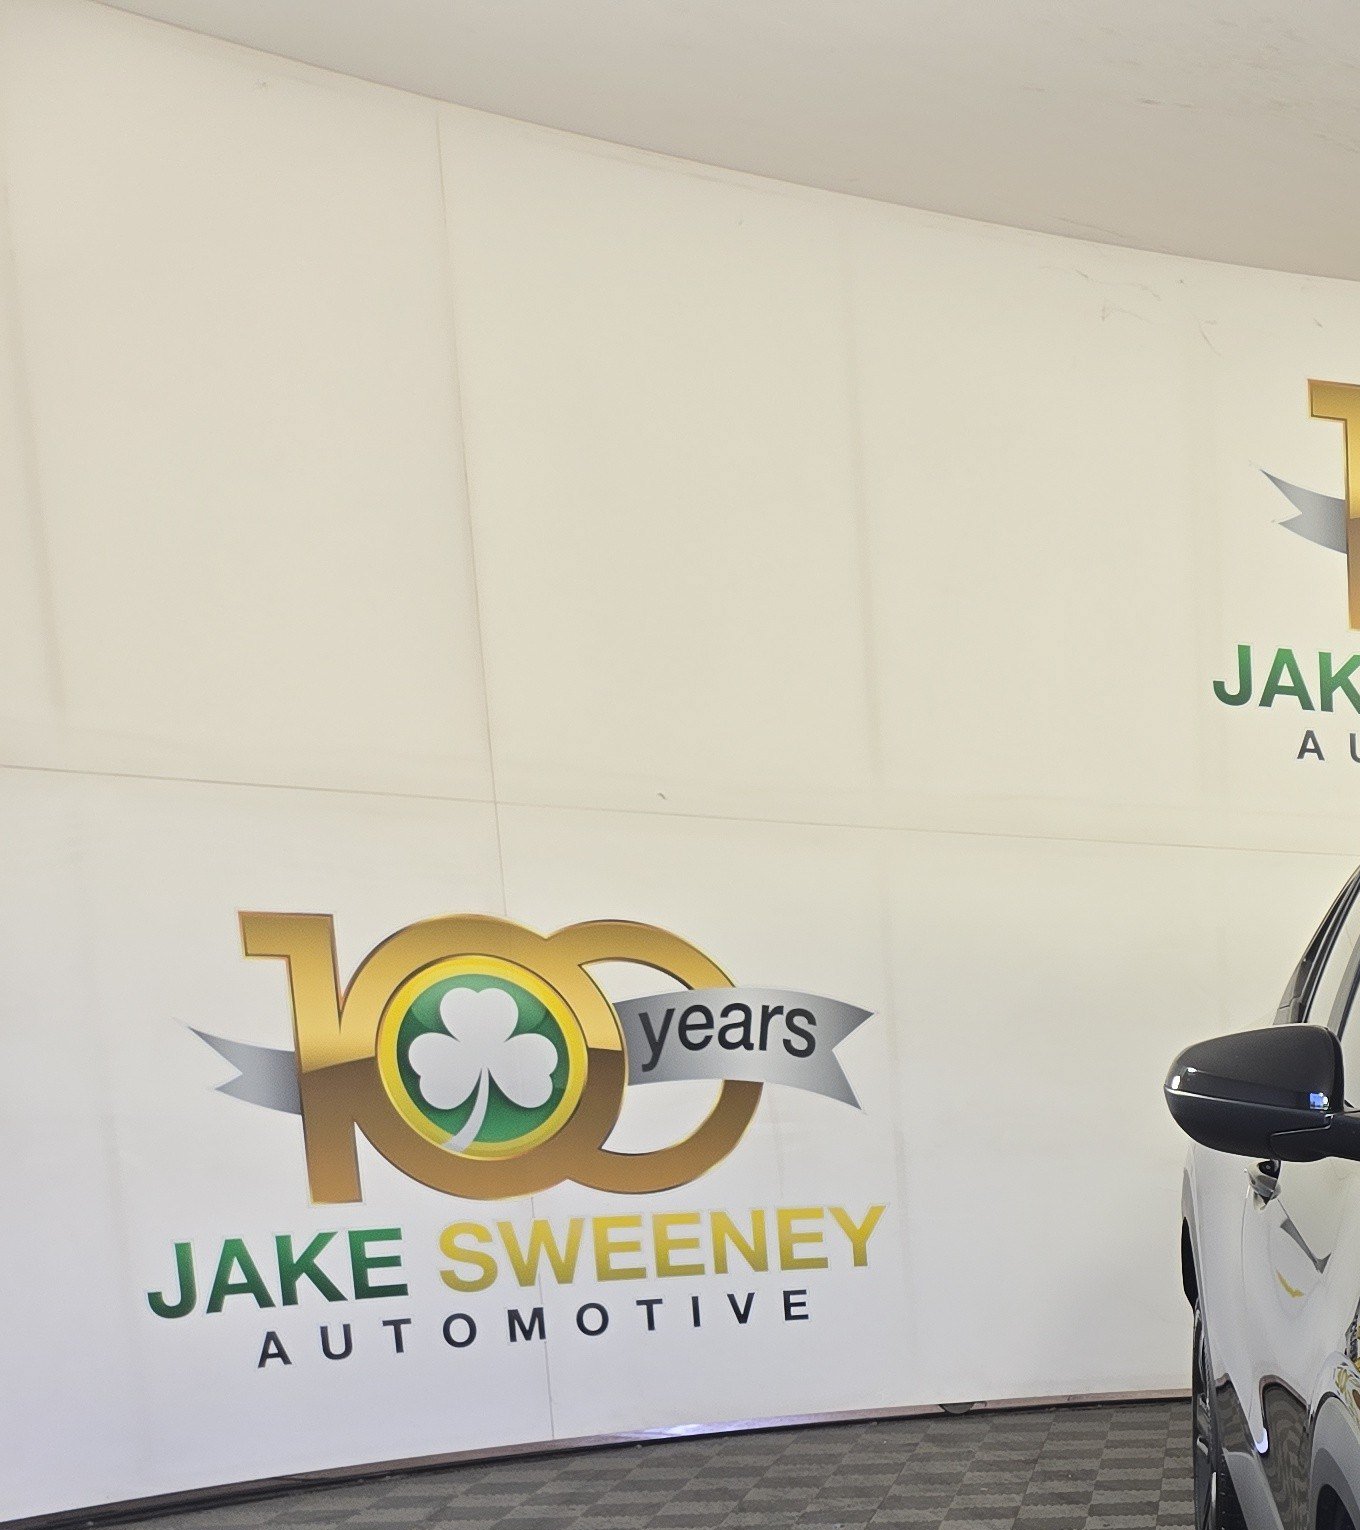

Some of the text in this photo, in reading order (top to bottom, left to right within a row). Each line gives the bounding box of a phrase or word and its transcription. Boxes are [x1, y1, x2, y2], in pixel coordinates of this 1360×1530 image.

[238, 911, 765, 1205] 100
[639, 1001, 818, 1073] years
[146, 1205, 887, 1321] JAKE SWEENEY
[257, 1289, 811, 1368] AUTOMOTIVE
